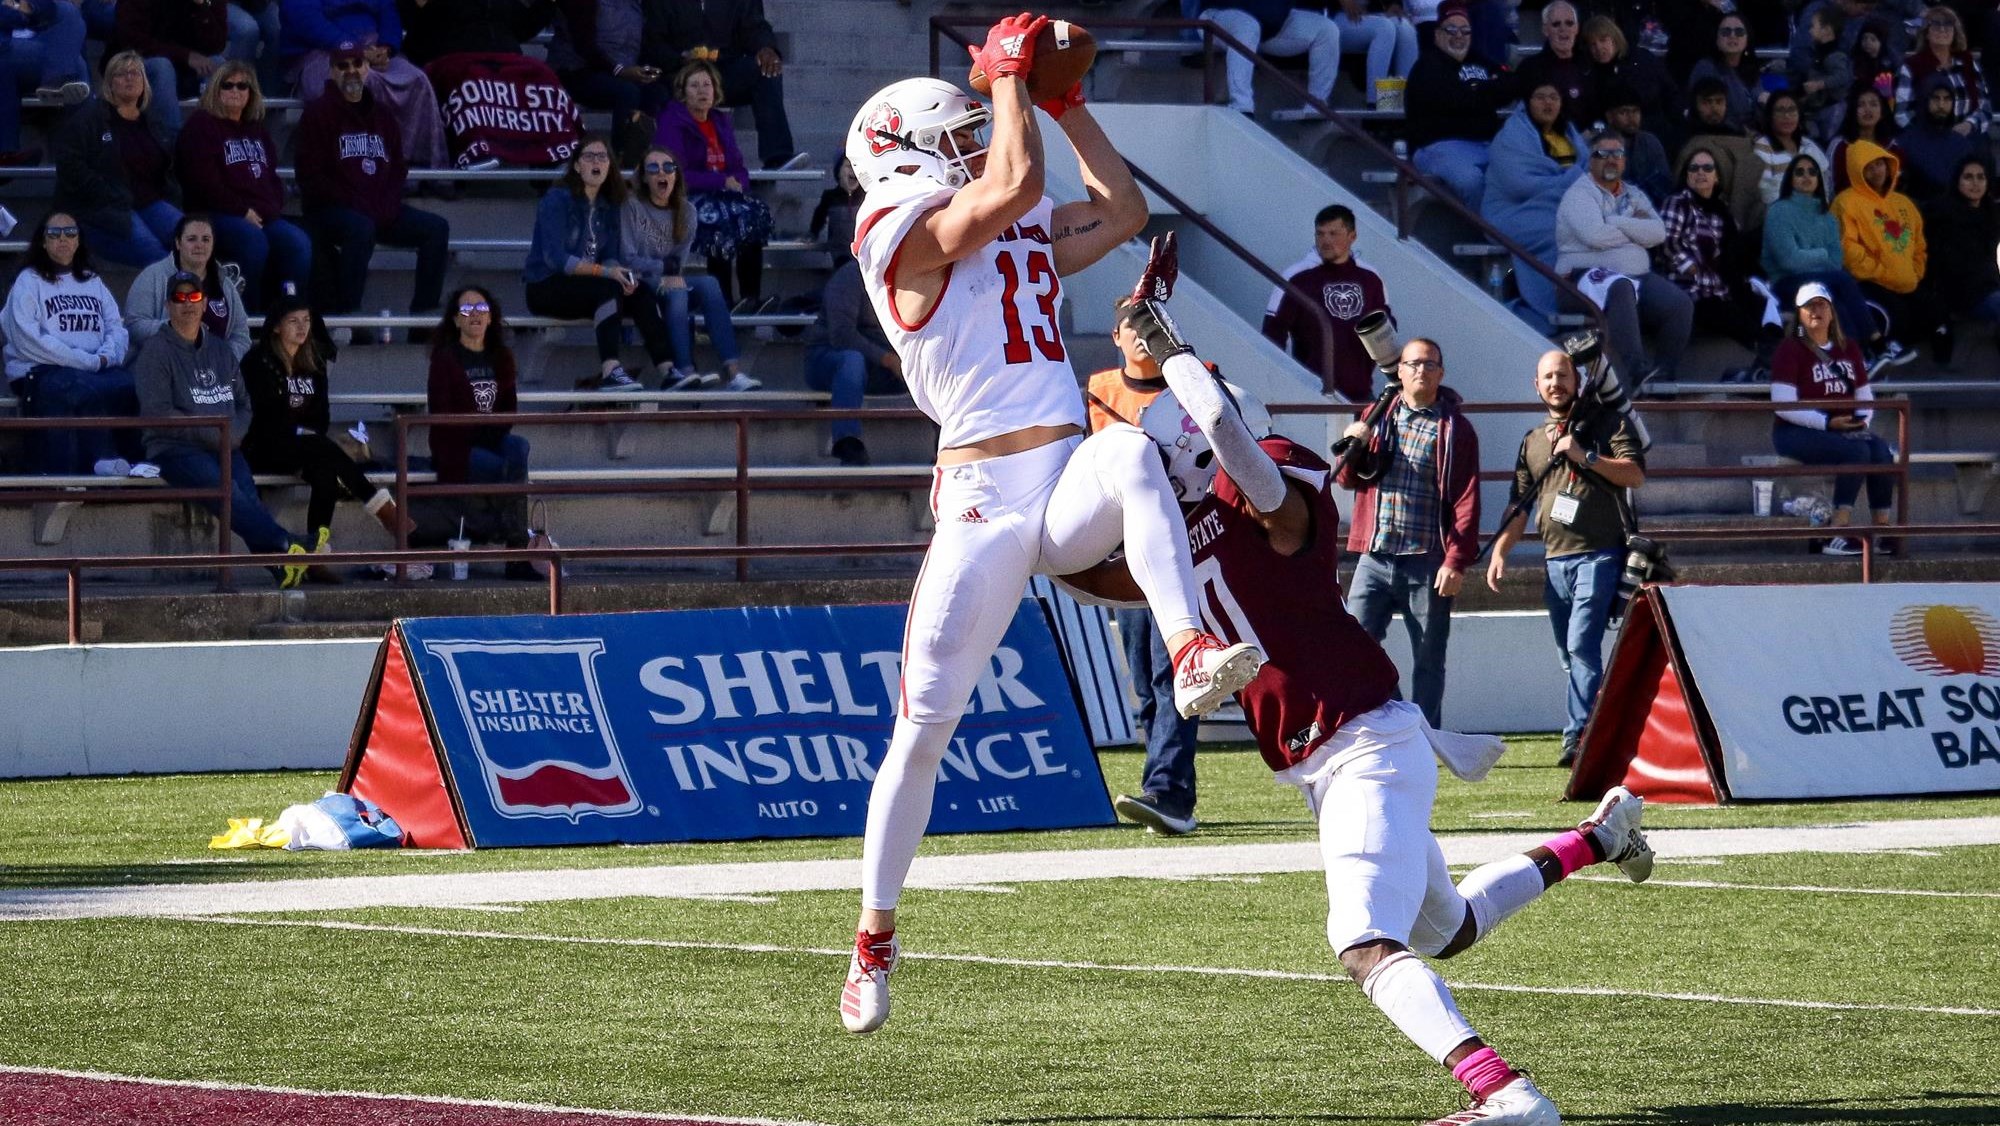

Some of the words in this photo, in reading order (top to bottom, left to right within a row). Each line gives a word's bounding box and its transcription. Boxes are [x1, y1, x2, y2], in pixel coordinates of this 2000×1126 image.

[453, 106, 564, 135] UNIVERSITY
[59, 314, 101, 332] STATE
[995, 250, 1065, 364] 13
[1189, 508, 1225, 554] STATE
[470, 689, 590, 716] SHELTER
[639, 647, 1046, 725] SHELTR
[477, 714, 594, 734] INSURANCE
[1782, 687, 1925, 735] GREAT
[1941, 682, 2000, 724] SO
[663, 729, 1067, 791] INSURNCE
[1931, 726, 2000, 769] BA
[758, 800, 818, 819] AUTO
[977, 796, 1019, 814] LIFE
